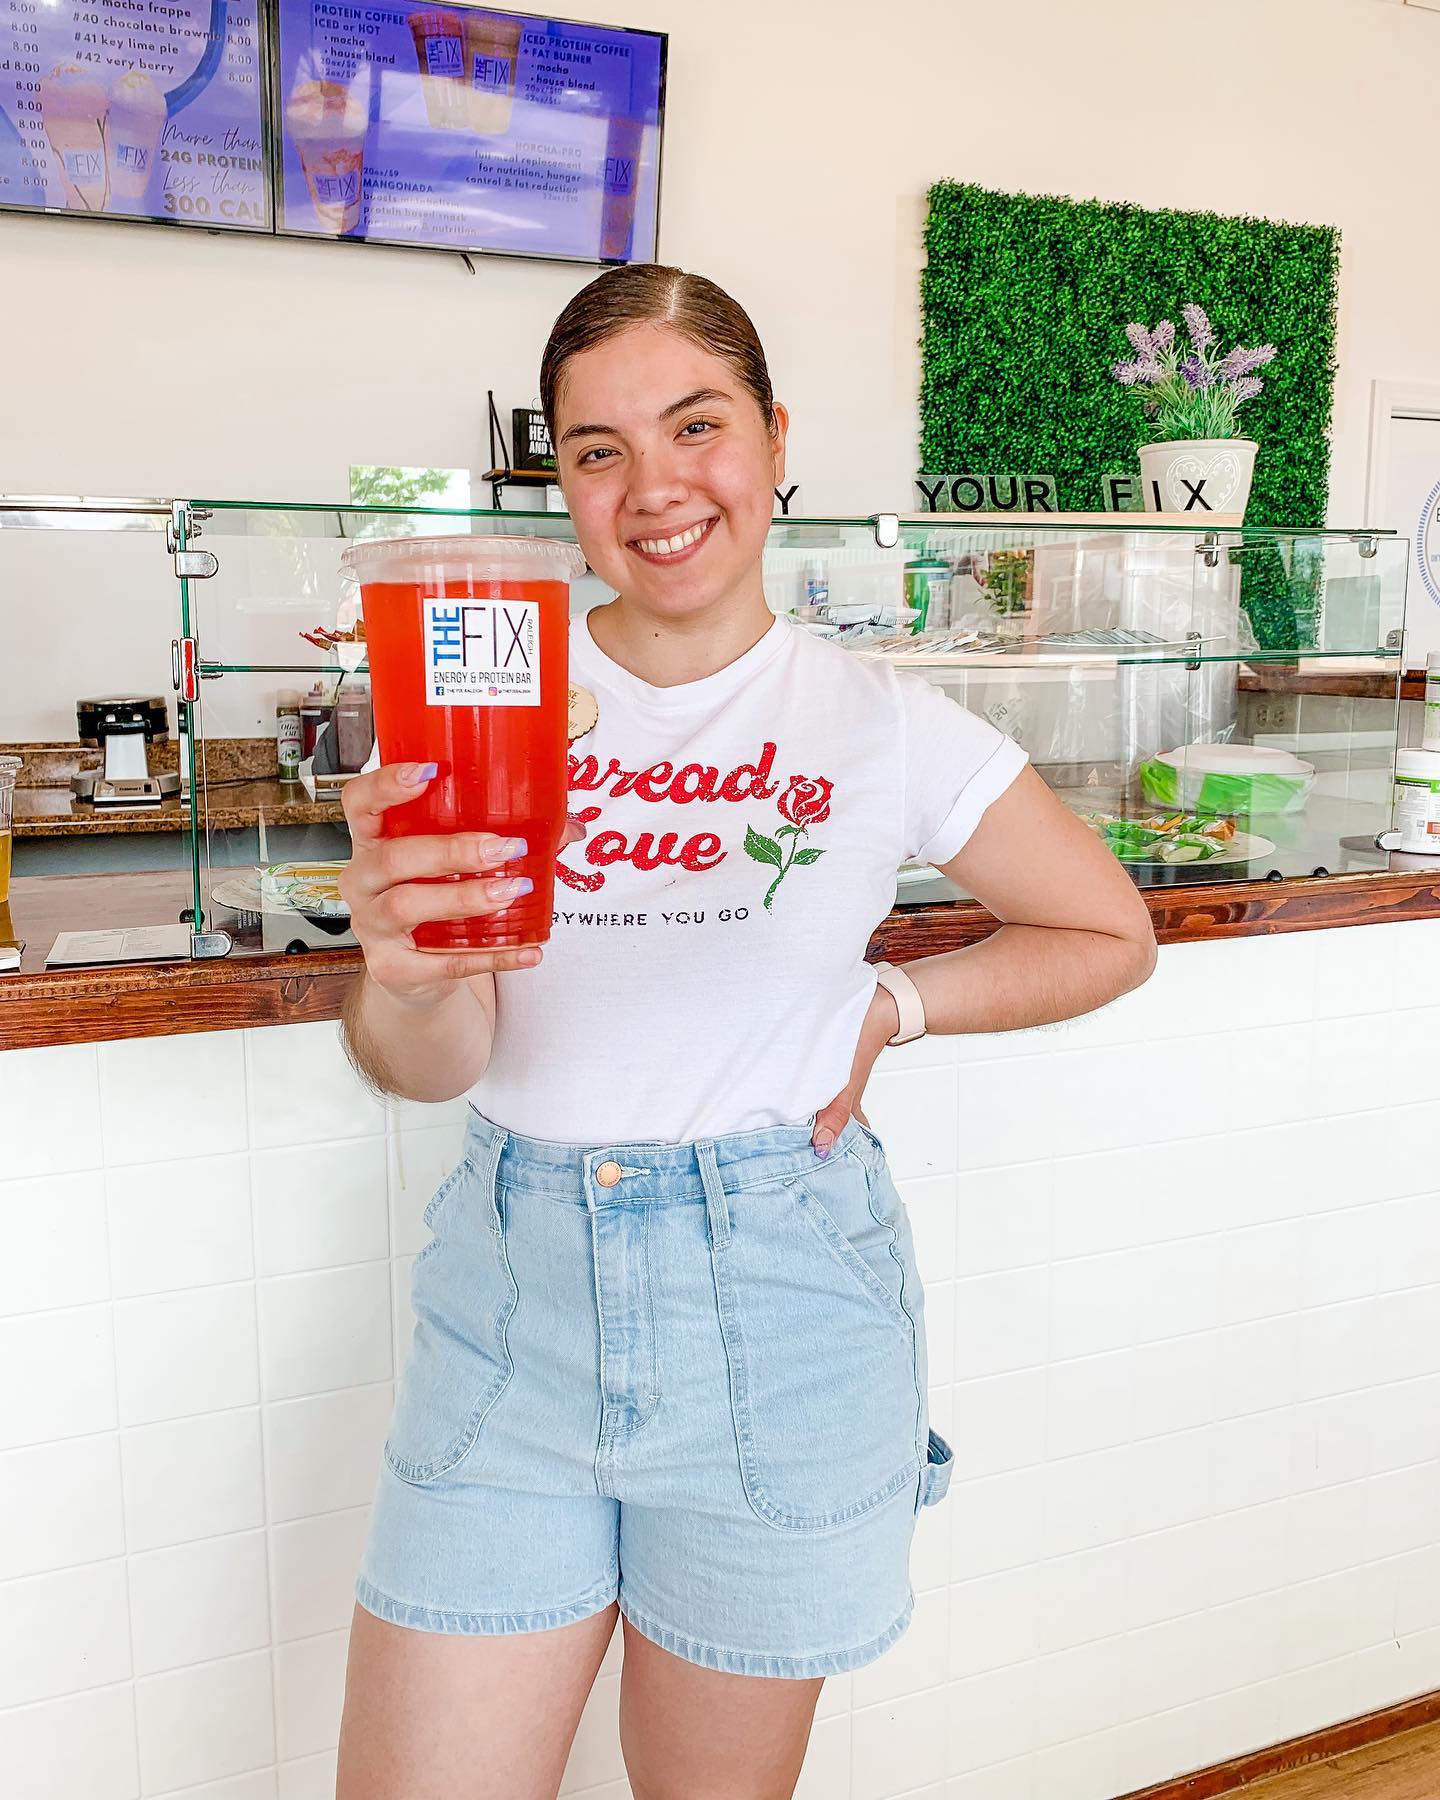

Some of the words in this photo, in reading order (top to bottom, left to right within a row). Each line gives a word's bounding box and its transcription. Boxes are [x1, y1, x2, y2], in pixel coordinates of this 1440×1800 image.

[148, 0, 191, 18] frappe
[314, 4, 361, 19] PROTEIN
[365, 11, 404, 25] COFFEE
[103, 16, 165, 33] chocolate
[226, 15, 250, 27] 8.00
[314, 18, 339, 30] ICED
[343, 23, 354, 31] or
[358, 24, 381, 36] HOT
[101, 33, 124, 49] key
[128, 37, 155, 51] lime
[159, 43, 179, 55] pie
[330, 36, 365, 47] mocha
[523, 33, 546, 45] ICED
[549, 38, 592, 52] PROTEIN
[594, 43, 630, 57] COFFEE
[330, 46, 362, 59] house
[365, 51, 395, 64] blend
[436, 40, 460, 63] FIX
[531, 48, 549, 59] FAT
[553, 51, 592, 64] BURNER
[14, 61, 40, 73] 8.00
[106, 57, 134, 70] very
[139, 58, 174, 74] berry
[475, 57, 485, 80] THE
[483, 59, 508, 84] FIX
[536, 63, 569, 75] mocha
[16, 81, 41, 92] 8.00
[536, 74, 565, 88] house
[568, 78, 595, 91] blend
[17, 100, 42, 112] 8.00
[18, 119, 44, 131] 8.00
[162, 119, 213, 146] More
[221, 127, 262, 151] than
[75, 153, 101, 174] FIX
[161, 149, 192, 164] 24G
[197, 152, 262, 170] PROTEIN
[521, 157, 582, 169] replacement
[479, 163, 494, 173] for
[496, 166, 544, 179] nutrition,
[547, 170, 582, 183] hunger
[605, 158, 631, 183] FIX
[163, 166, 200, 192] Less
[211, 169, 255, 194] than
[326, 175, 354, 198] FIX
[363, 178, 433, 192] MANGONADA
[465, 176, 501, 186] control
[504, 179, 512, 187] &
[515, 179, 529, 189] fat
[531, 182, 578, 194] reduction
[164, 193, 211, 215] 300
[220, 199, 263, 219] CAL
[528, 425, 550, 442] HEA
[528, 441, 548, 455] AND
[915, 477, 1052, 512] YOUR
[1109, 478, 1213, 512] FIX
[432, 606, 461, 666] THE
[461, 606, 530, 668] FIX
[433, 671, 469, 684] ENERGY
[470, 672, 477, 684] &
[478, 672, 514, 684] PROTEIN
[515, 673, 532, 684] BAR
[567, 742, 780, 804] pread
[551, 911, 648, 926] RYWHERE
[661, 911, 705, 925] YOU
[718, 907, 749, 921] GO
